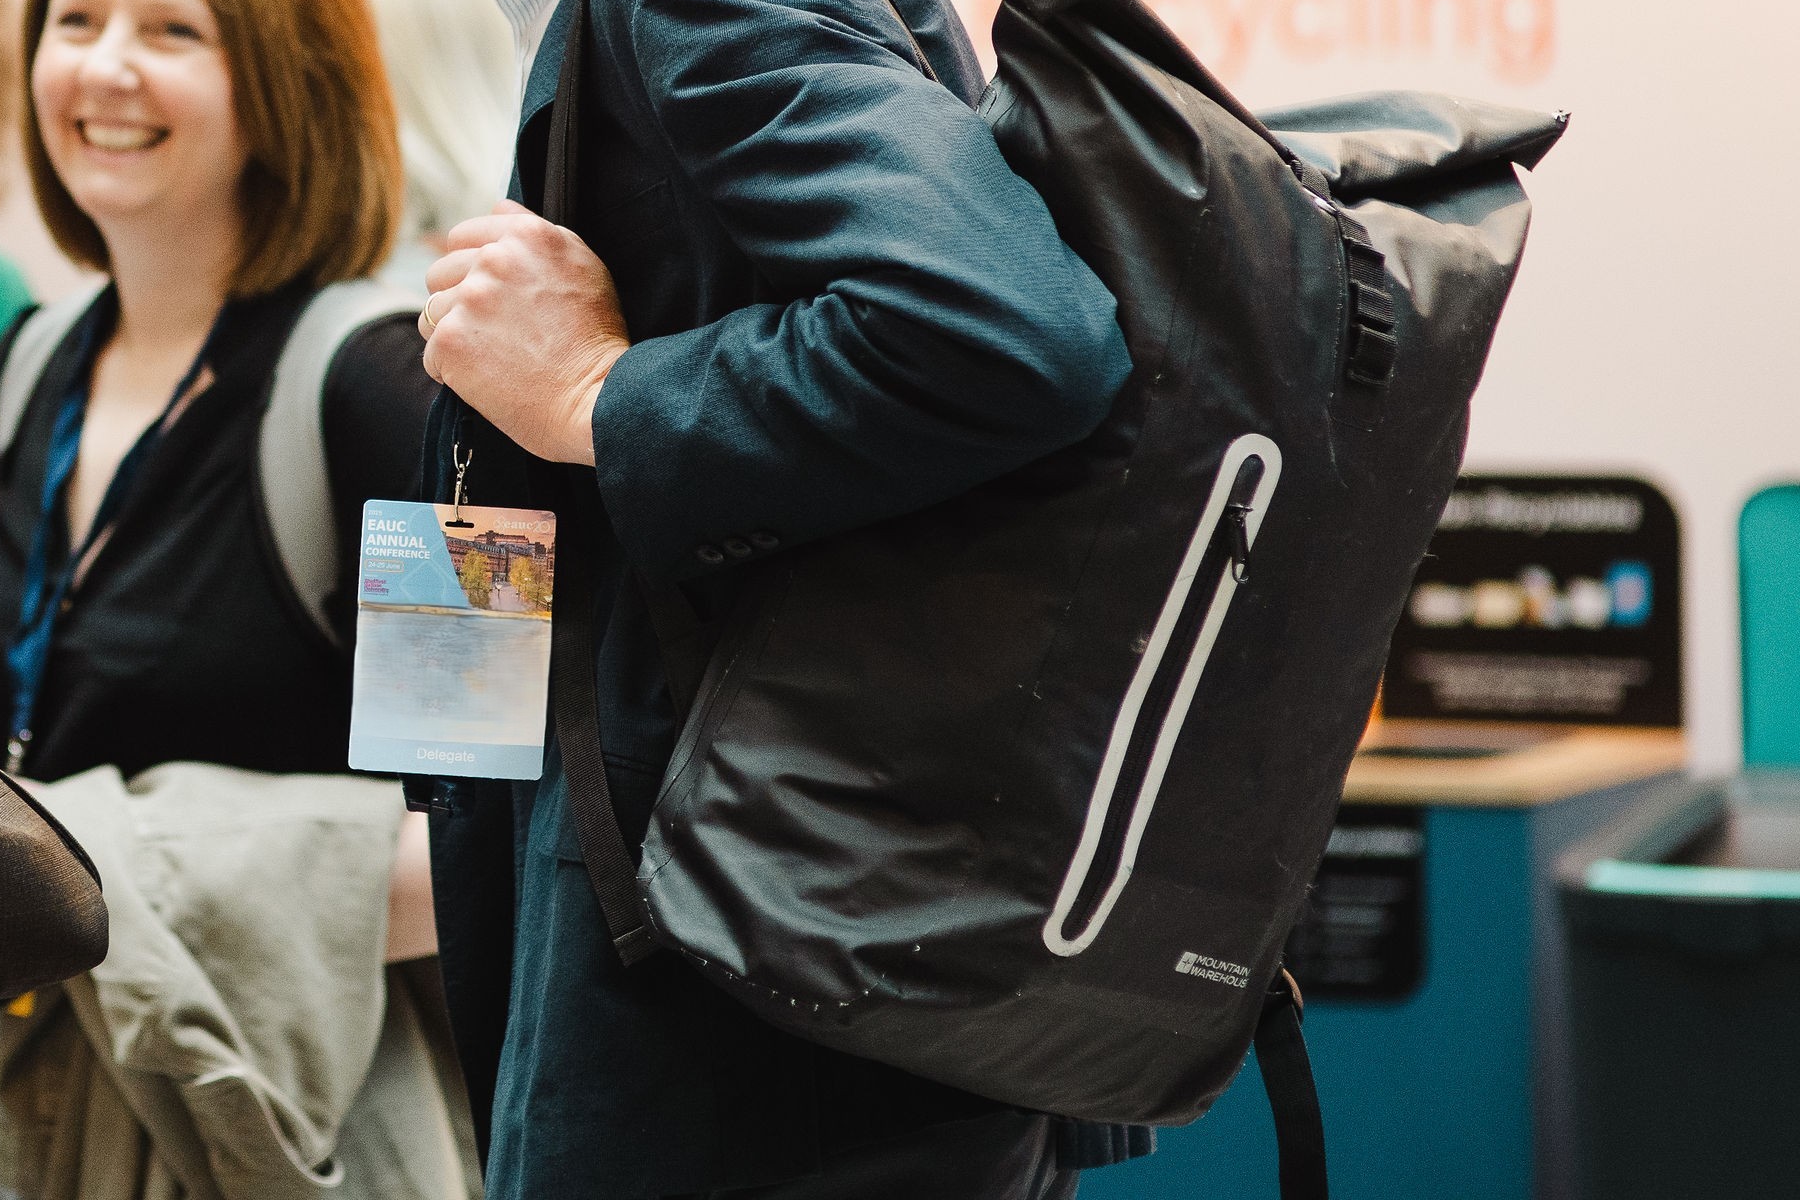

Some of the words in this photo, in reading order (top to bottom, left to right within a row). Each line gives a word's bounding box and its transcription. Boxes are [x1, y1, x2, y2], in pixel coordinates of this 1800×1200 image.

[367, 519, 407, 533] EAUC
[366, 534, 427, 549] ANNUAL
[365, 547, 431, 560] CONFERENCE
[417, 747, 476, 764] Delegate
[1196, 955, 1251, 977] MOUNTAIN
[1190, 966, 1250, 989] WAREHOUS
